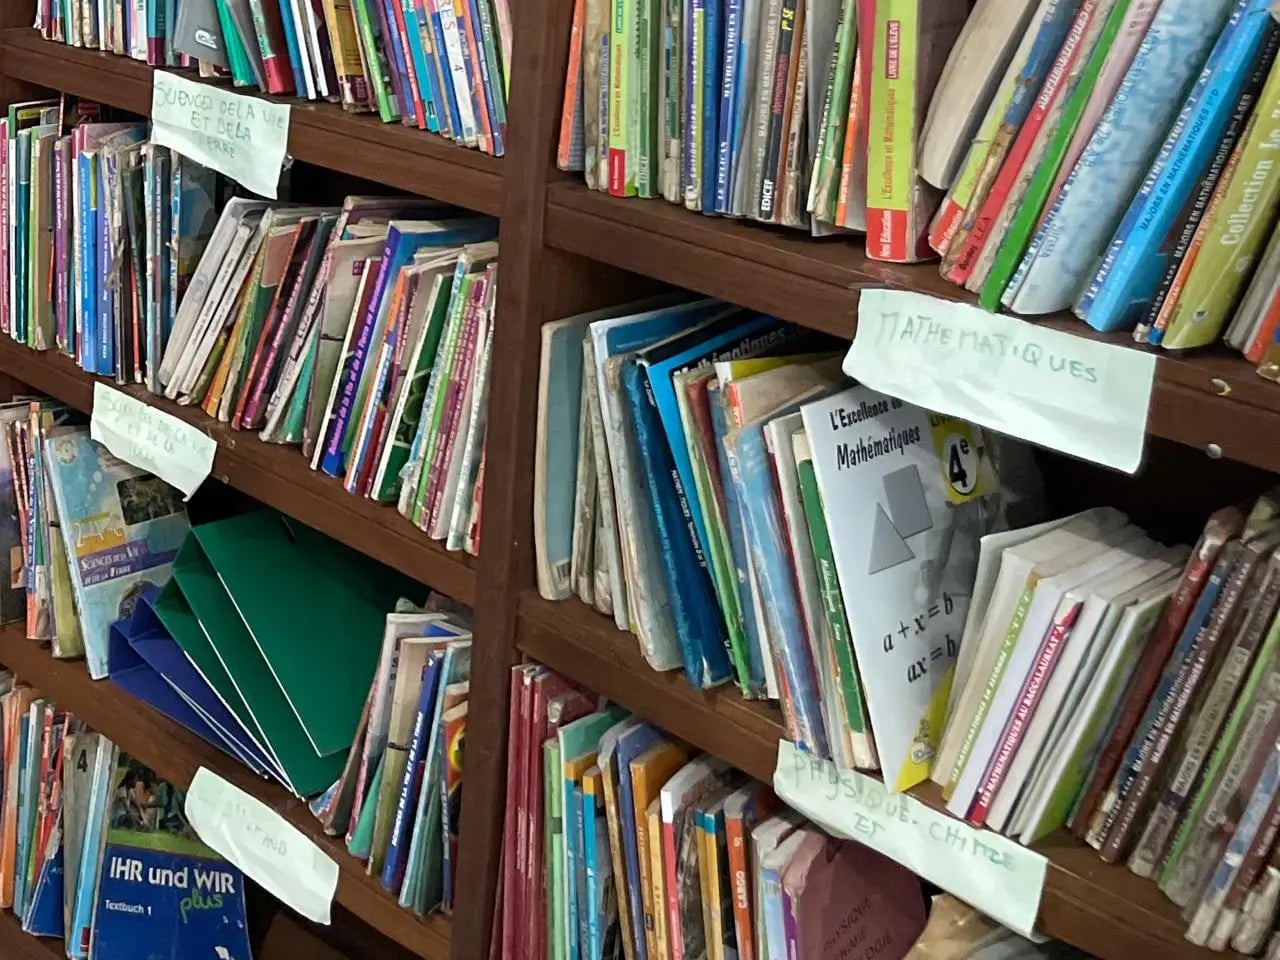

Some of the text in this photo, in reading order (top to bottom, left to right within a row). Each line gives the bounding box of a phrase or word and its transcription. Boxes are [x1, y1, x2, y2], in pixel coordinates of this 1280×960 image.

[886, 59, 897, 77] LIVRE
[760, 178, 773, 210] EDICEF
[1139, 180, 1172, 231] MAJORS EN
[1218, 152, 1274, 250] Collection
[1172, 208, 1201, 259] MAJORS EN
[879, 312, 1098, 384] MATHEMATIQUES
[830, 400, 889, 431] L'Excellence
[837, 425, 921, 471] Mathématiques
[978, 635, 1059, 807] LES MATHEMATIQUES AU BACCALAUREAT
[77, 749, 88, 773] 4
[1149, 721, 1175, 763] MAJORS EN
[109, 856, 234, 893] IHR und WIR
[735, 870, 747, 908] CARGO
[104, 899, 145, 914] Textbuch
[180, 890, 224, 924] plus
